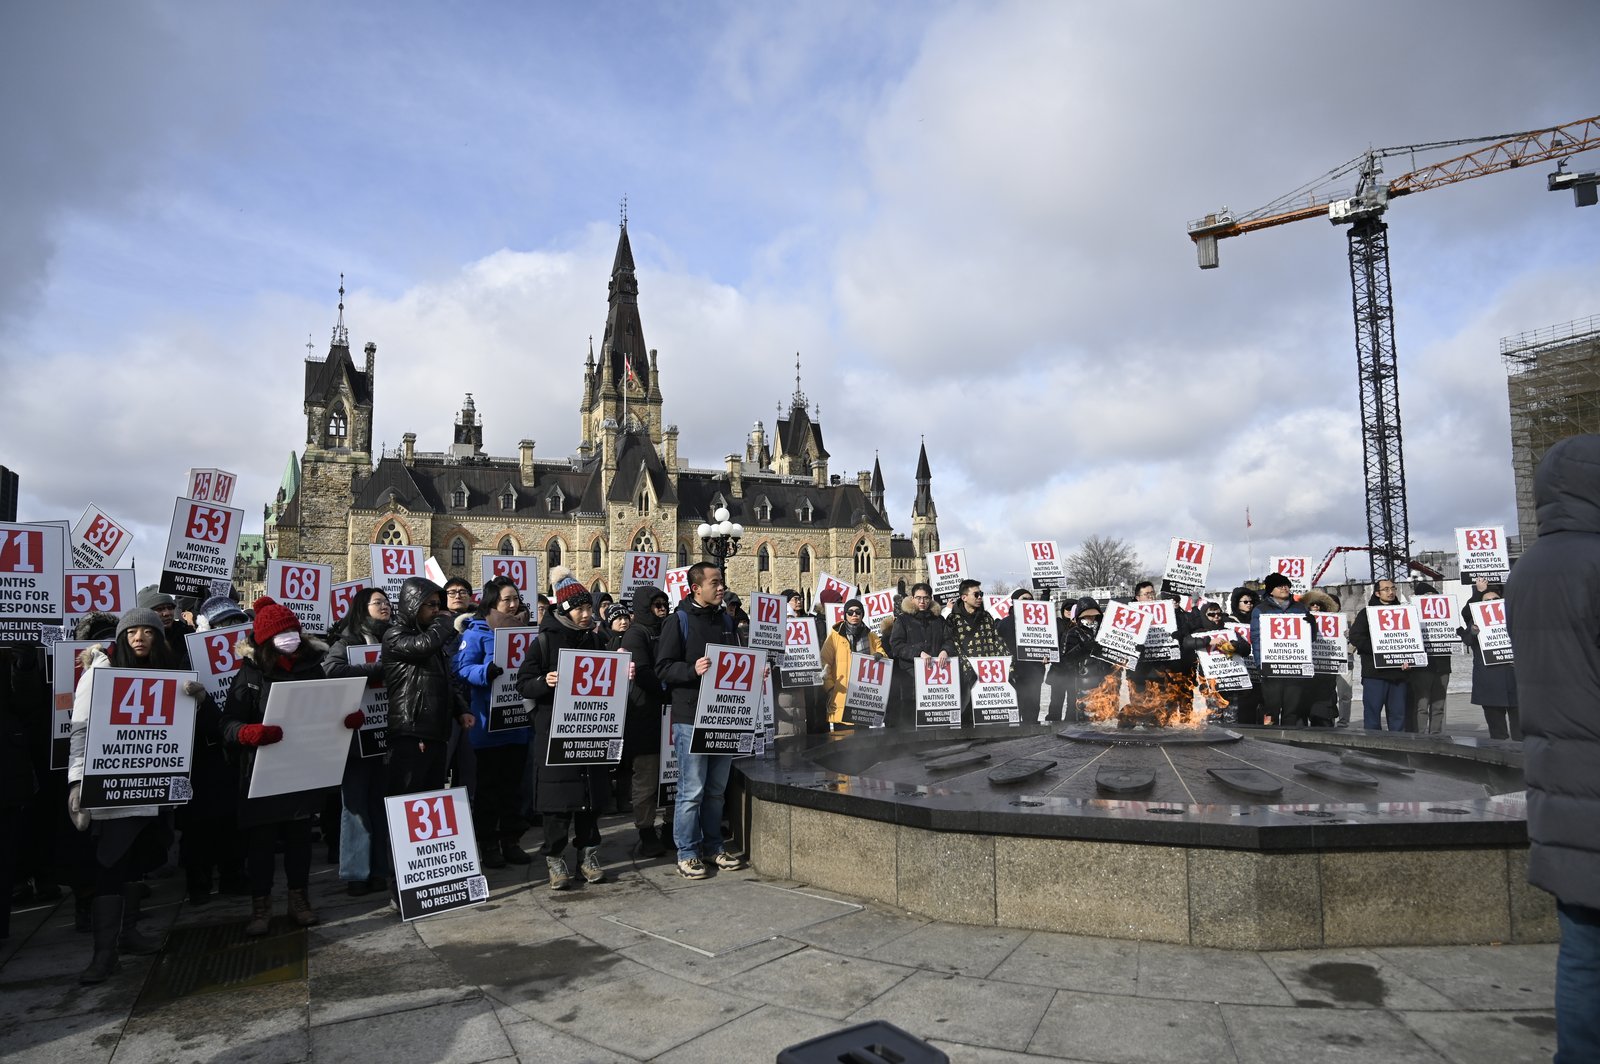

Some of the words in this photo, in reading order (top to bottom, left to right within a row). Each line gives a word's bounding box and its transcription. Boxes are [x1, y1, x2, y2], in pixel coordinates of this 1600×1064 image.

[215, 475, 229, 502] 31
[192, 507, 225, 542] 53
[89, 519, 118, 551] 39
[1469, 530, 1494, 550] 33
[81, 543, 104, 562] MONTHS
[177, 551, 209, 565] WAITING
[211, 557, 226, 566] FOR
[187, 543, 219, 555] MONTHS
[1035, 544, 1051, 560] 19
[1180, 543, 1201, 563] 17
[169, 560, 188, 570] IRCC
[188, 563, 228, 576] RESPONSE
[386, 550, 412, 574] 34
[635, 557, 657, 578] 38
[939, 554, 957, 573] 43
[1280, 560, 1301, 577] 28
[286, 568, 315, 600] 68
[26, 591, 49, 600] FOR
[71, 576, 114, 612] 53
[284, 602, 314, 611] MONTHS
[761, 598, 777, 622] 72
[869, 594, 890, 616] 20
[1026, 603, 1045, 625] 33
[1424, 599, 1446, 618] 40
[1115, 609, 1141, 633] 32
[1382, 609, 1405, 630] 37
[1486, 605, 1506, 625] 11
[787, 623, 807, 644] 23
[1274, 619, 1298, 639] 31
[1316, 617, 1335, 637] 13
[576, 657, 612, 696] 34
[719, 653, 750, 689] 22
[862, 660, 879, 684] 11
[928, 662, 949, 684] 25
[981, 660, 1003, 683] 33
[497, 694, 512, 703] IRCC
[716, 694, 745, 703] MONTHS
[853, 692, 872, 700] WAITING
[859, 686, 878, 694] MONTHS
[119, 679, 166, 724] 41
[574, 702, 608, 710] MONTHS
[707, 705, 736, 714] WAITING
[737, 706, 751, 715] FOR
[859, 700, 884, 709] RESPONSE
[564, 713, 597, 721] WAITING
[600, 713, 615, 721] FOR
[701, 716, 716, 724] IRCC
[717, 716, 753, 726] RESPONSE
[117, 730, 167, 740] MONTHS
[557, 724, 575, 733] IRCC
[576, 724, 618, 733] RESPONSE
[102, 744, 152, 754] WAITING
[156, 743, 179, 754] FOR
[92, 758, 120, 769] IRCC
[122, 757, 184, 768] RESPONSE
[103, 779, 117, 788] NO
[120, 777, 170, 787] TIMELINES
[106, 790, 120, 800] NO
[123, 788, 165, 799] RESULTS
[412, 798, 453, 840] 31
[416, 841, 455, 856] MONTHS
[408, 855, 447, 870] WAITING
[450, 850, 467, 862] FOR
[404, 872, 425, 884] IRCC
[428, 862, 474, 880] RESPONSE
[416, 890, 427, 899] NO
[429, 880, 468, 896] TIMELINES
[422, 900, 432, 909] NO
[434, 892, 467, 907] RESULTS
